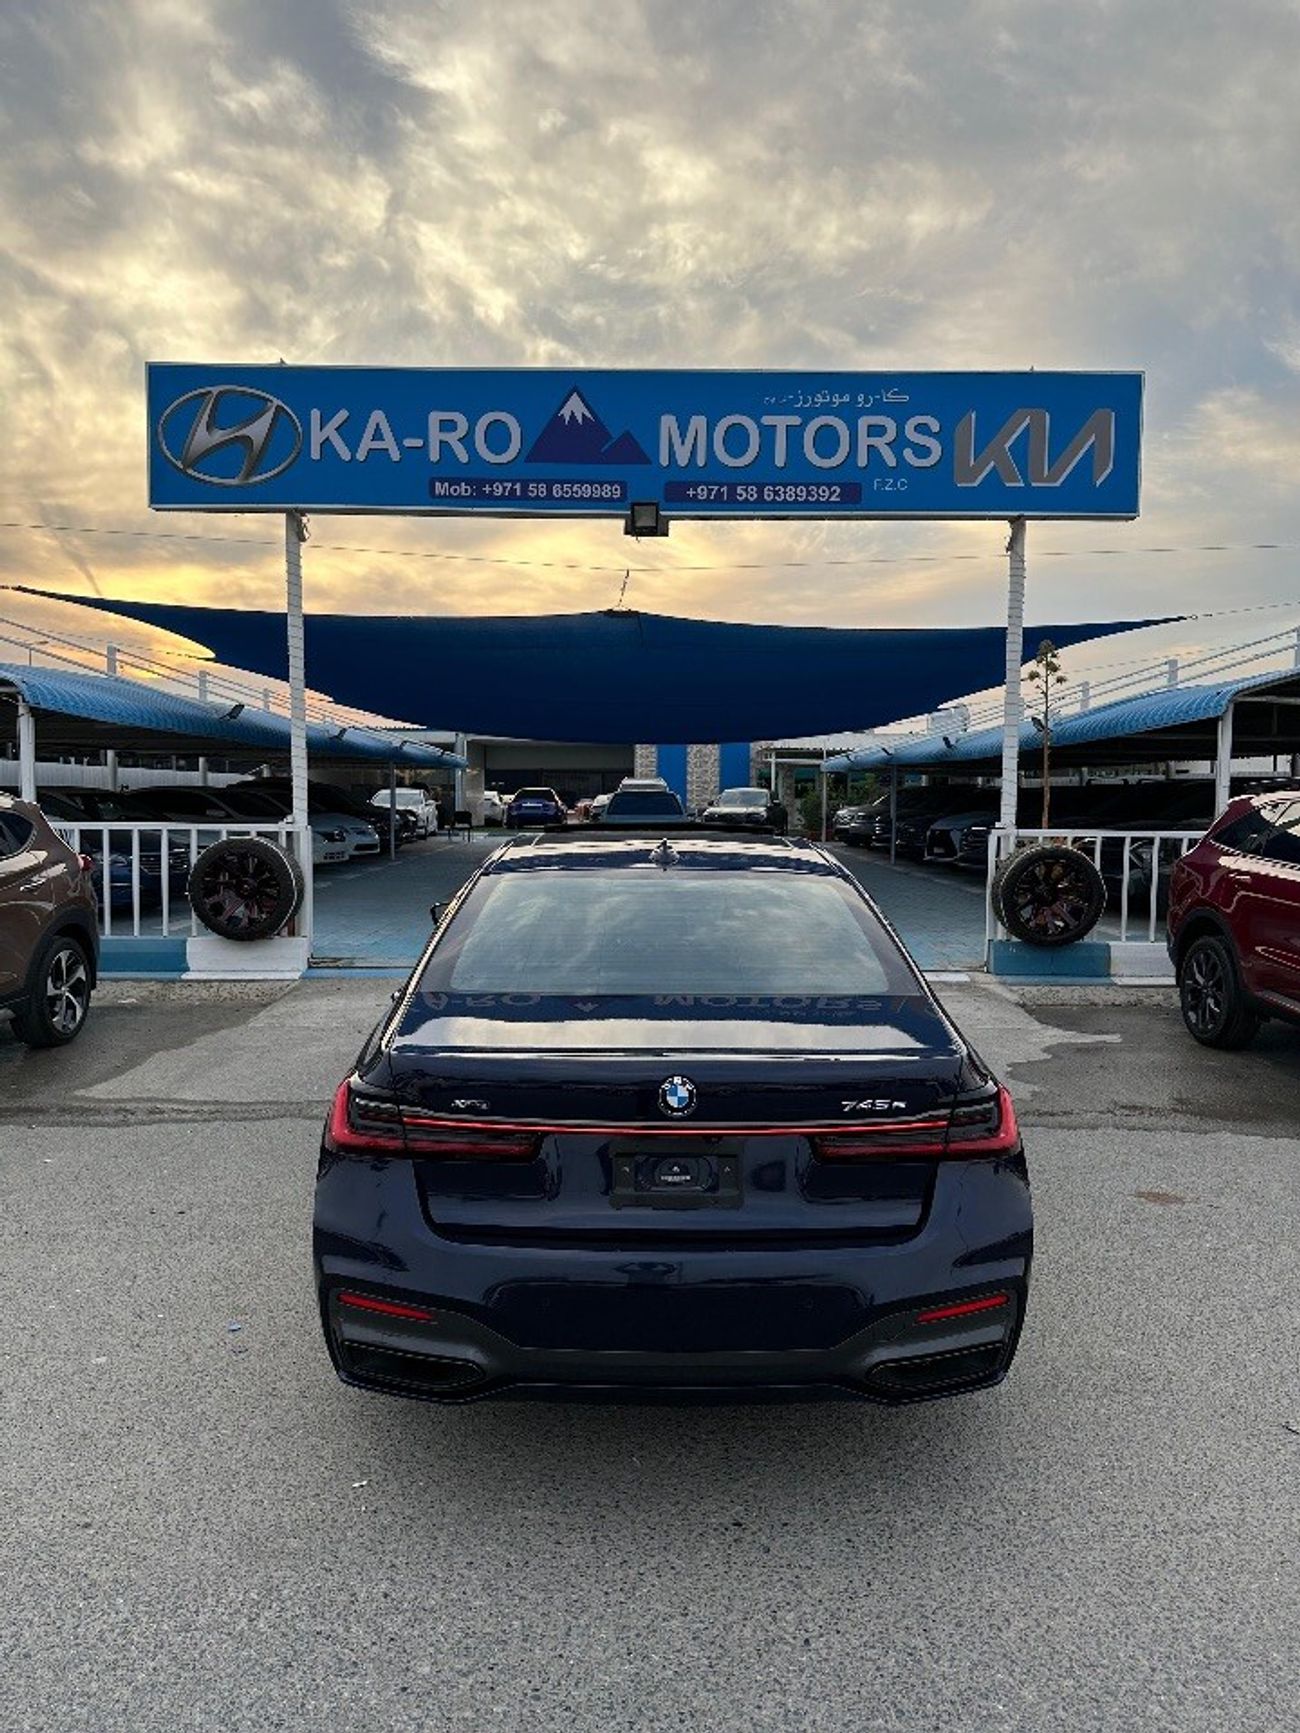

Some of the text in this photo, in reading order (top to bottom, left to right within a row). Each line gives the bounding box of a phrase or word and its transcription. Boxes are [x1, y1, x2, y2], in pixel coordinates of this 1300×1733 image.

[309, 408, 943, 469] KA-RO MOTORS
[434, 482, 622, 499] Mob: +971 58 6559989
[685, 485, 841, 502] +971 58 6389392
